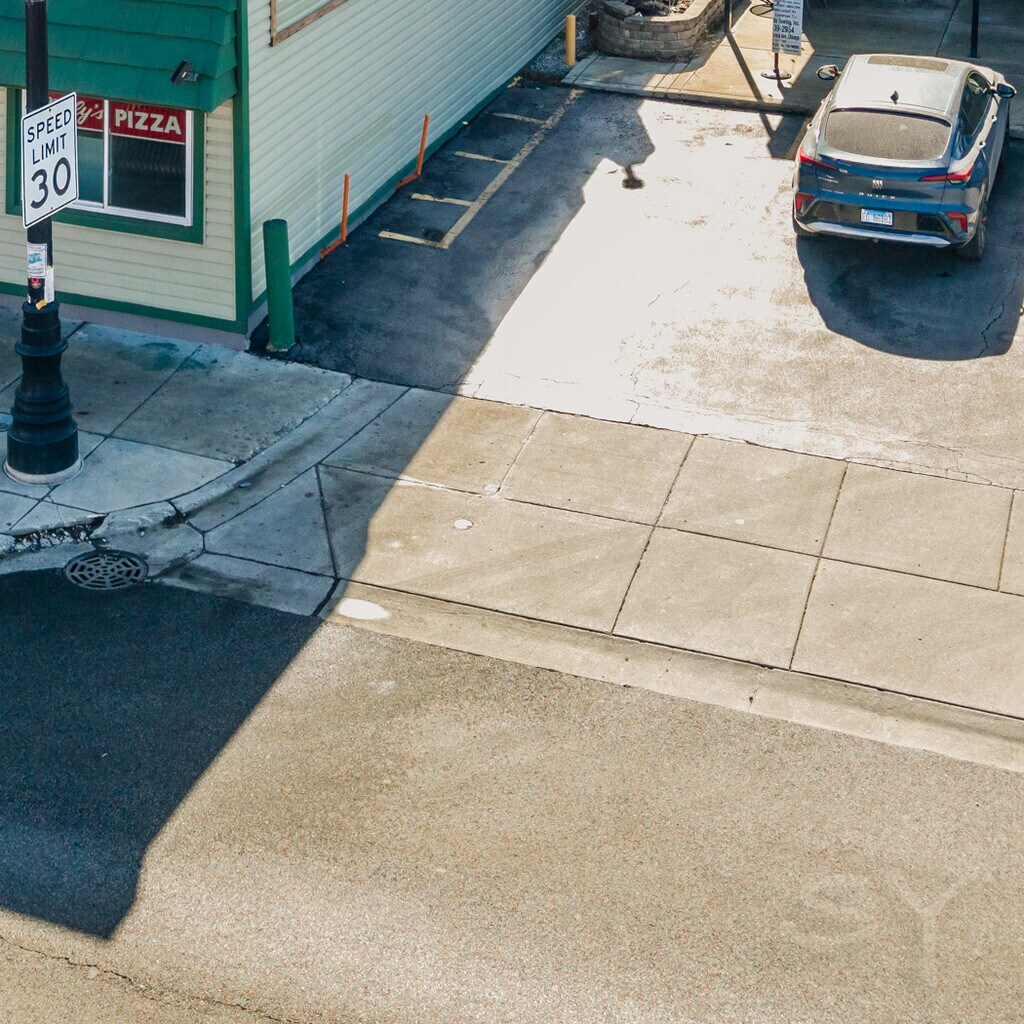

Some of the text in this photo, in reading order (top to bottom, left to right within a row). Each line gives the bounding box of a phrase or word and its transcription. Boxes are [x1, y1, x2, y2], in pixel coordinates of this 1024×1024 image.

[27, 108, 72, 143] SPEED
[115, 108, 182, 135] PIZZA
[32, 133, 67, 165] LIMIT
[30, 157, 71, 209] 30
[858, 191, 896, 200] BUICK
